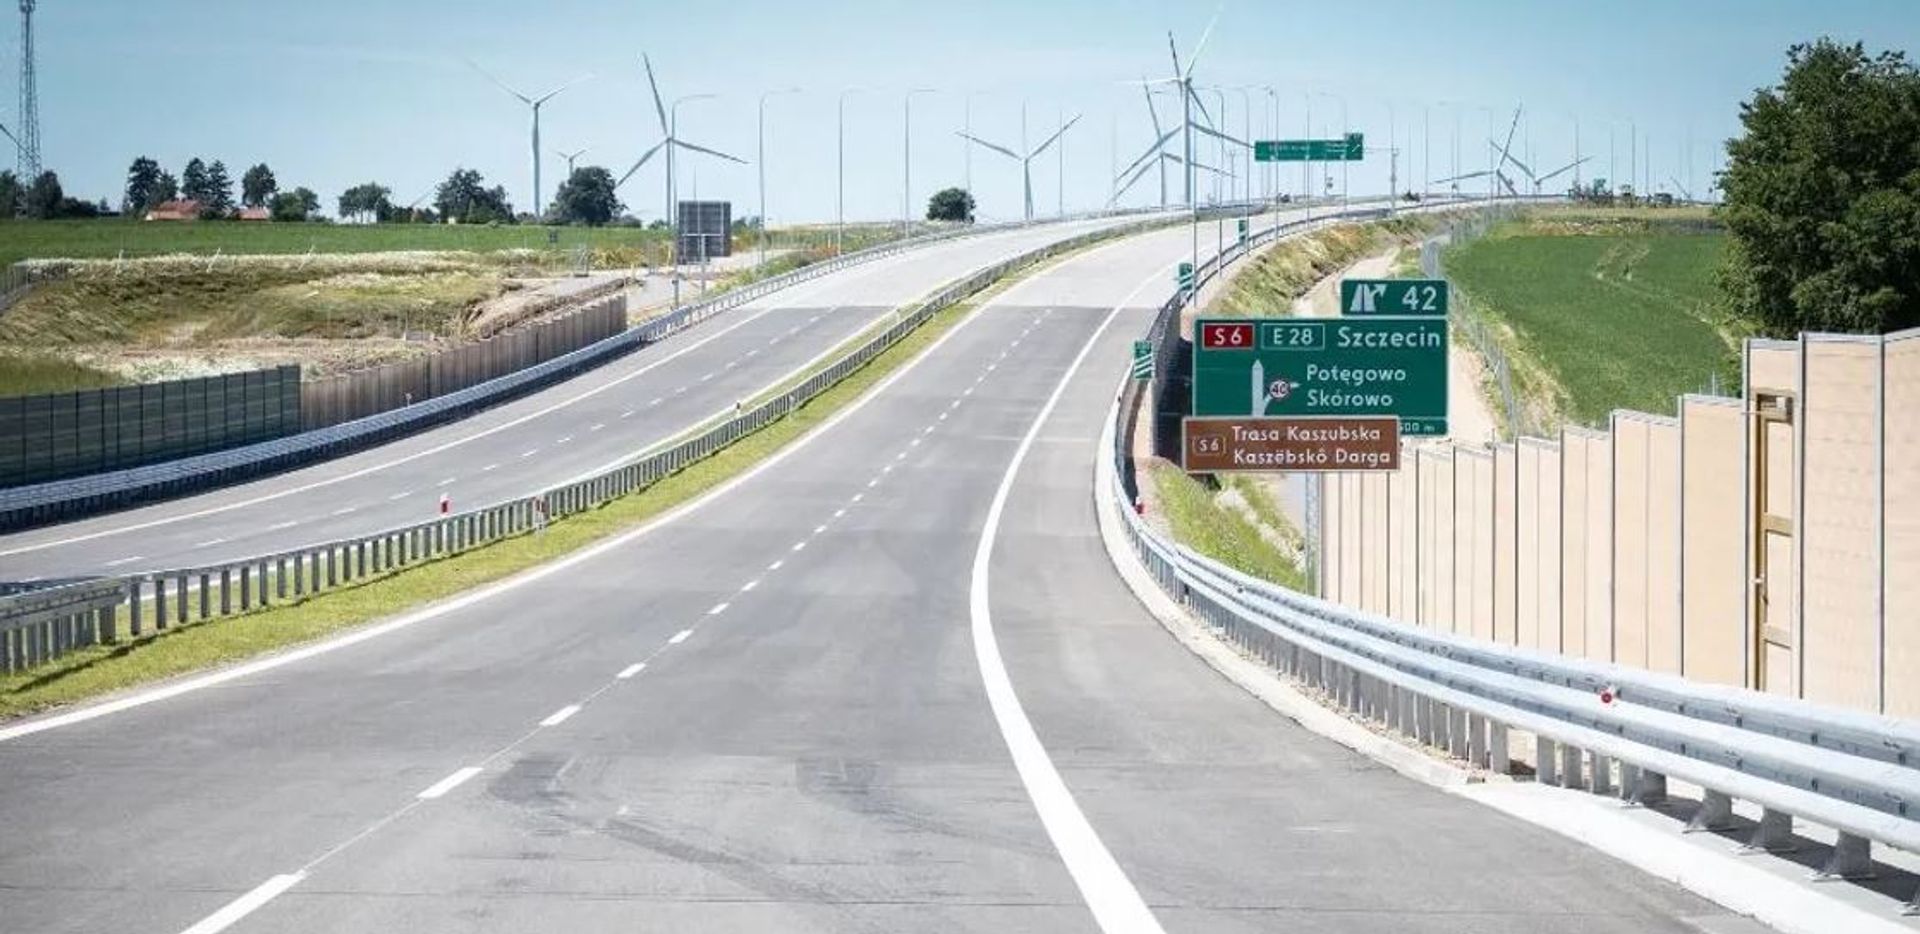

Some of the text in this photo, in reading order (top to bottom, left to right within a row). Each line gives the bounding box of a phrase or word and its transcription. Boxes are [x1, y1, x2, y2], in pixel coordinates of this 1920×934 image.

[1402, 286, 1437, 311] 42
[1214, 327, 1242, 345] S 6
[1273, 328, 1313, 345] E 28
[1337, 326, 1441, 348] Szczecin
[1306, 364, 1406, 385] Potęgowo
[1306, 389, 1393, 407] Skórowo
[1232, 425, 1380, 441] Trasa Kaszubska
[1335, 449, 1391, 467] Darga
